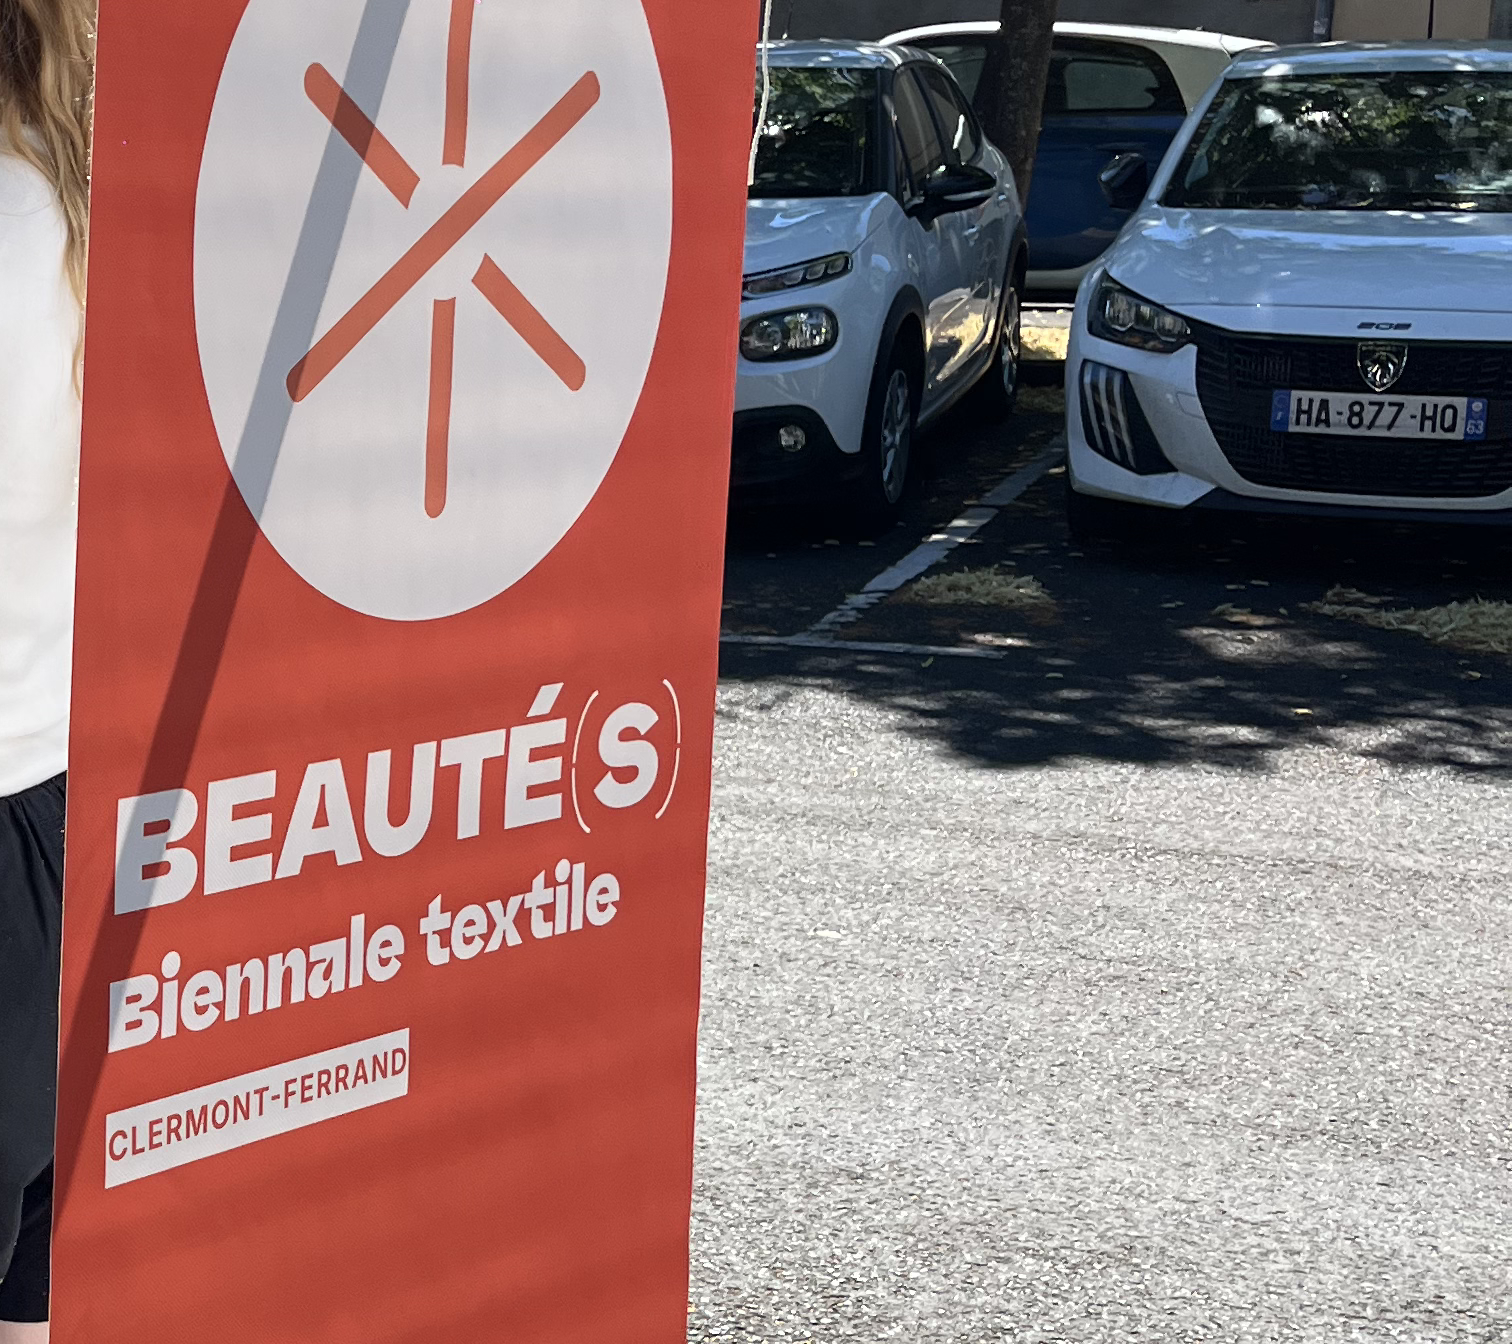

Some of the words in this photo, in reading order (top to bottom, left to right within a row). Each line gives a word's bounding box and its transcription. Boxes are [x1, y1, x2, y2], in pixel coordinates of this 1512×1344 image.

[1295, 397, 1458, 433] HA-877-HQ
[115, 679, 680, 915] BEAUTÉ(S)
[108, 913, 404, 1053] Biennale
[420, 859, 620, 965] textile
[108, 1047, 406, 1161] CLERMONT-FERRAND
